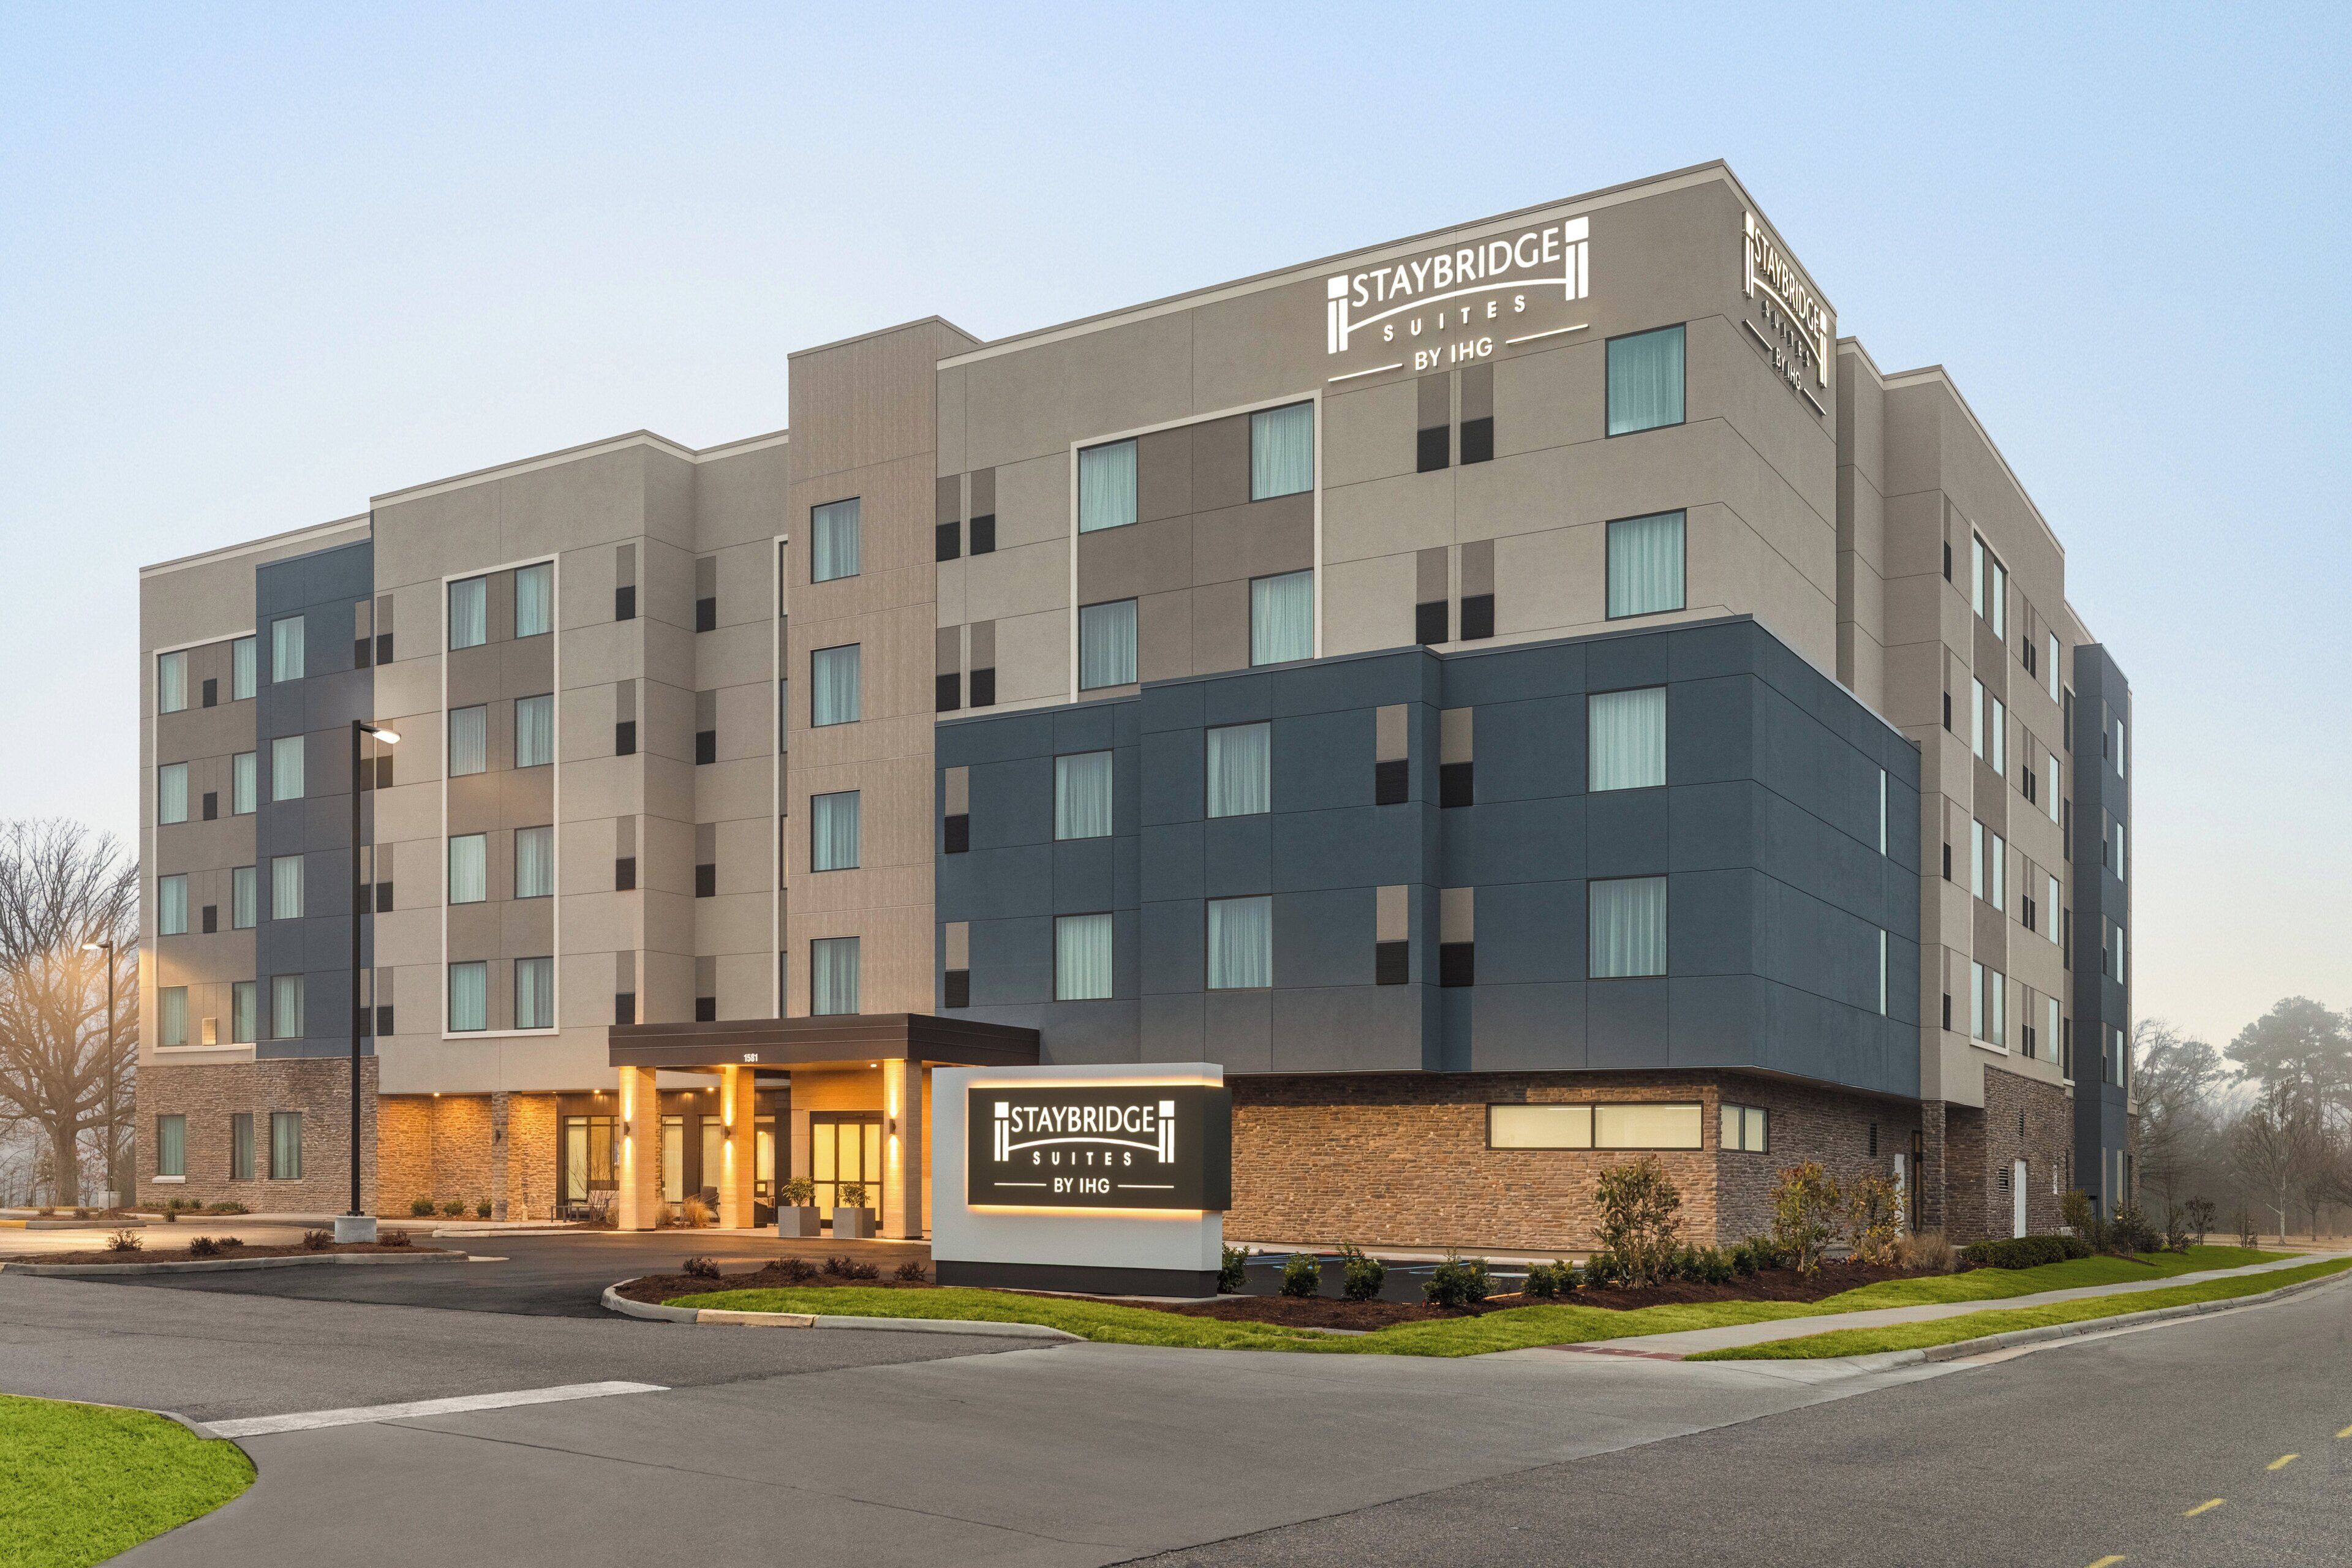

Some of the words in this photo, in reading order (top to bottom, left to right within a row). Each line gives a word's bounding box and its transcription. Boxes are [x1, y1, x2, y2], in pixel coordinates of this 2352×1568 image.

[1352, 227, 1561, 307] STAYBRIDGE
[1754, 227, 1820, 339] STAYBRIDGE
[1384, 295, 1526, 342] SUITES
[1765, 300, 1811, 368] SUITES
[1415, 347, 1442, 371] BY
[1450, 337, 1494, 364] IHG
[1776, 347, 1785, 372] BY
[1787, 361, 1801, 390] IHG
[744, 1054, 758, 1063] 1581
[1011, 1106, 1155, 1133] STAYBRIDGE
[1033, 1152, 1132, 1166] SUITES
[1054, 1177, 1074, 1193] BY
[1079, 1178, 1110, 1194] IHG
